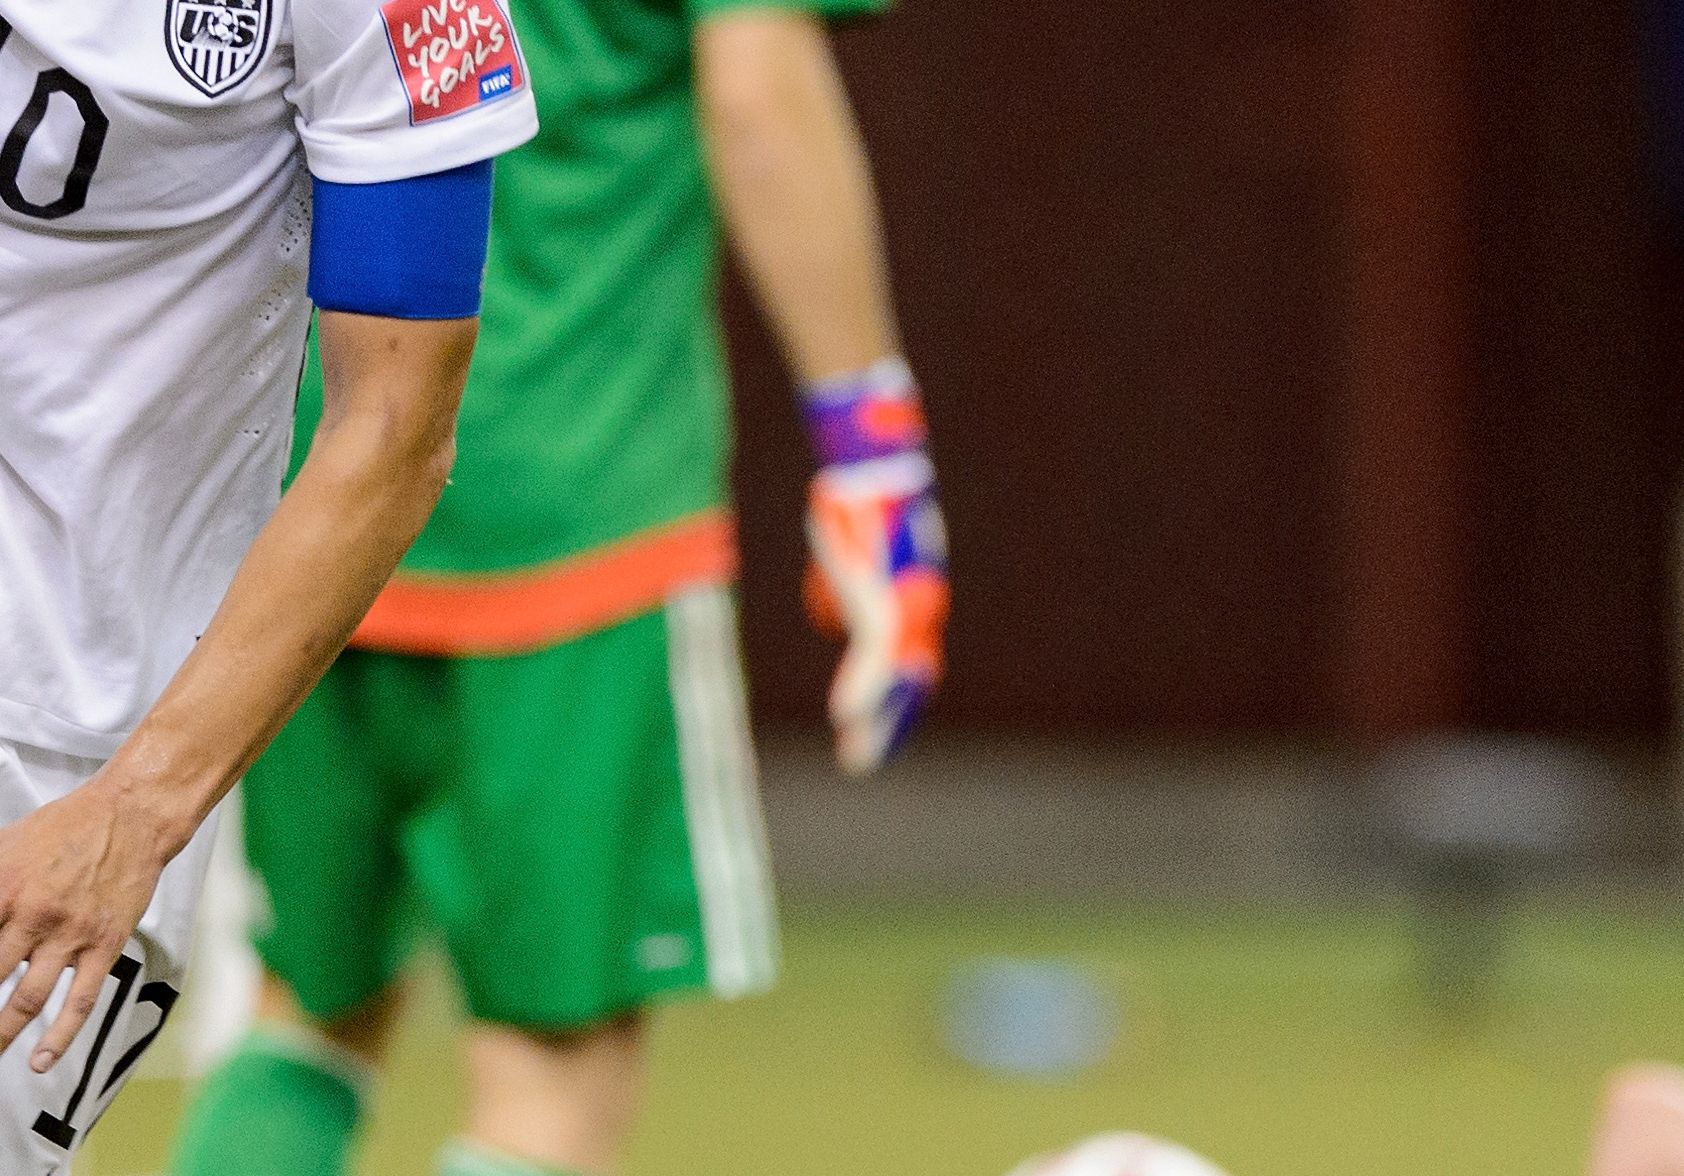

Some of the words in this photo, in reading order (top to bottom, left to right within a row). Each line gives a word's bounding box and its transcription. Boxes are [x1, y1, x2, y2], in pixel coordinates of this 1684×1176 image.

[407, 5, 494, 79] YOUR
[420, 22, 505, 109] GOALS
[480, 72, 512, 95] FIFA
